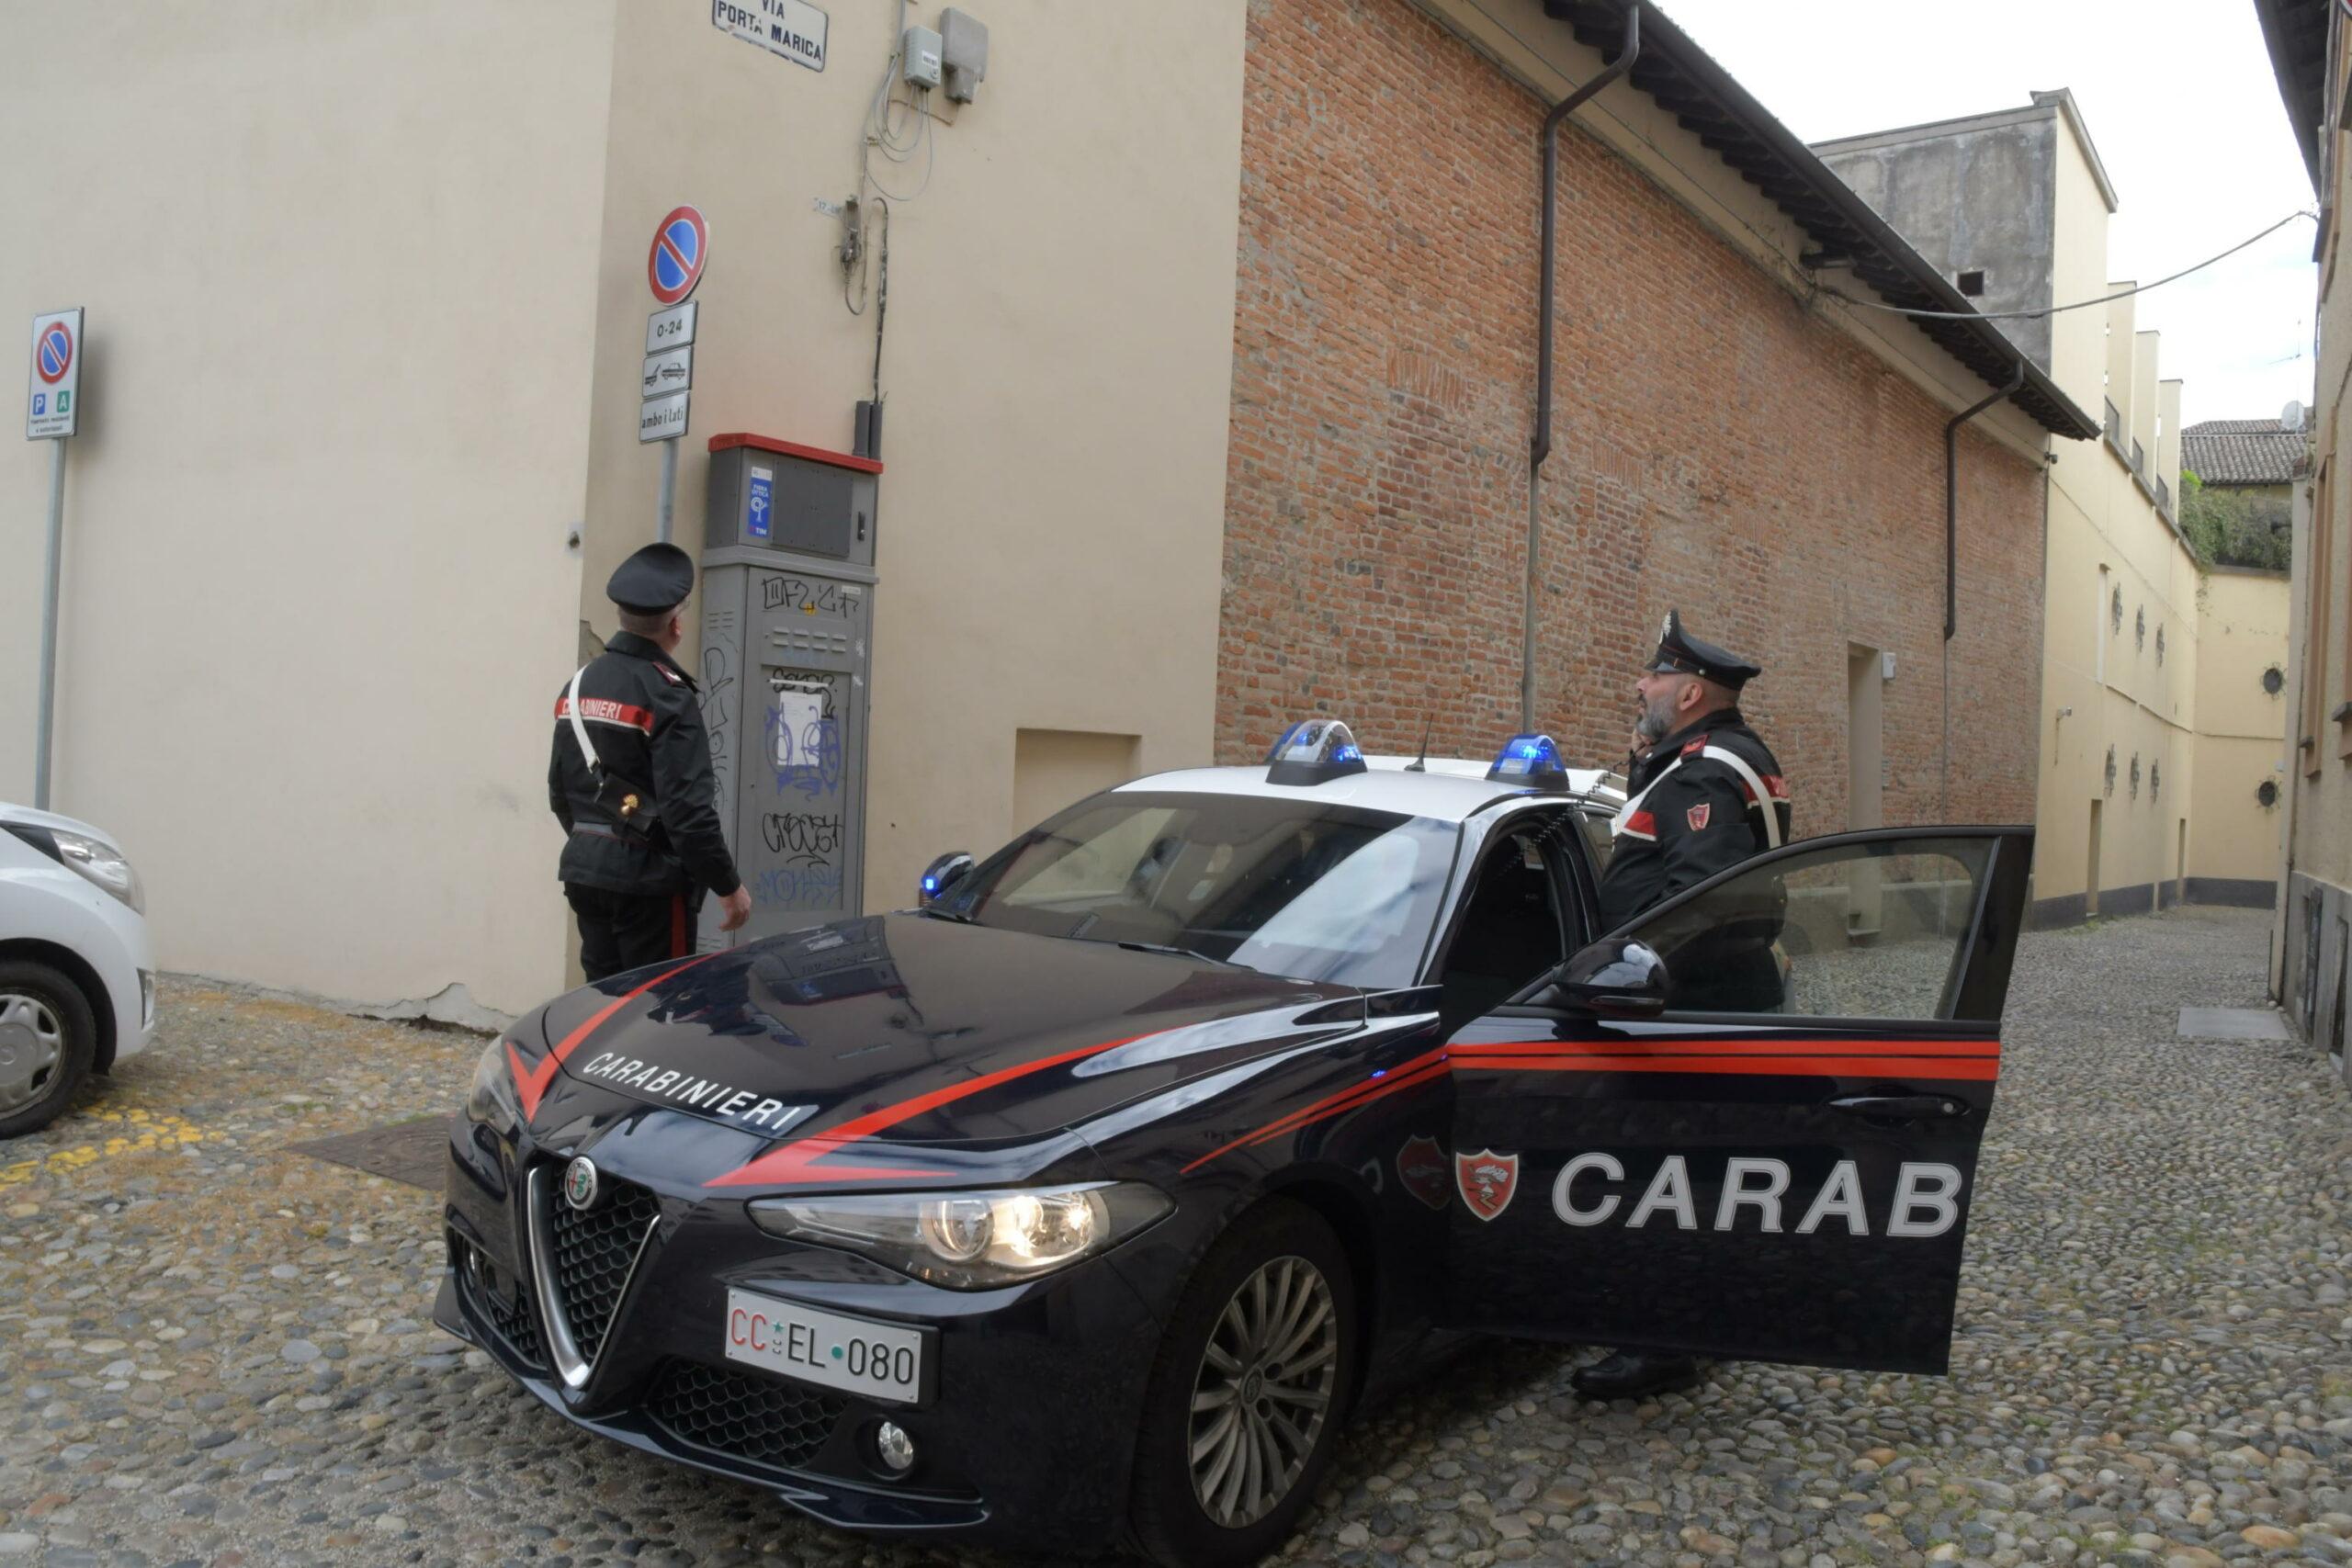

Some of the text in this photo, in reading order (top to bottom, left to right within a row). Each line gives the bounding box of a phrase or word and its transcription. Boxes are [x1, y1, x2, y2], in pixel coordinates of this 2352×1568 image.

[762, 0, 785, 19] VIA
[718, 0, 822, 62] PORTA MARICA
[35, 394, 67, 413] P A
[641, 406, 684, 429] ambo i lati
[755, 527, 767, 536] TIM
[582, 1052, 801, 1131] CARABINIERI
[1552, 1152, 1962, 1238] CARAB
[731, 1308, 767, 1351] CC
[787, 1322, 826, 1369] EL
[847, 1337, 914, 1385] 080
